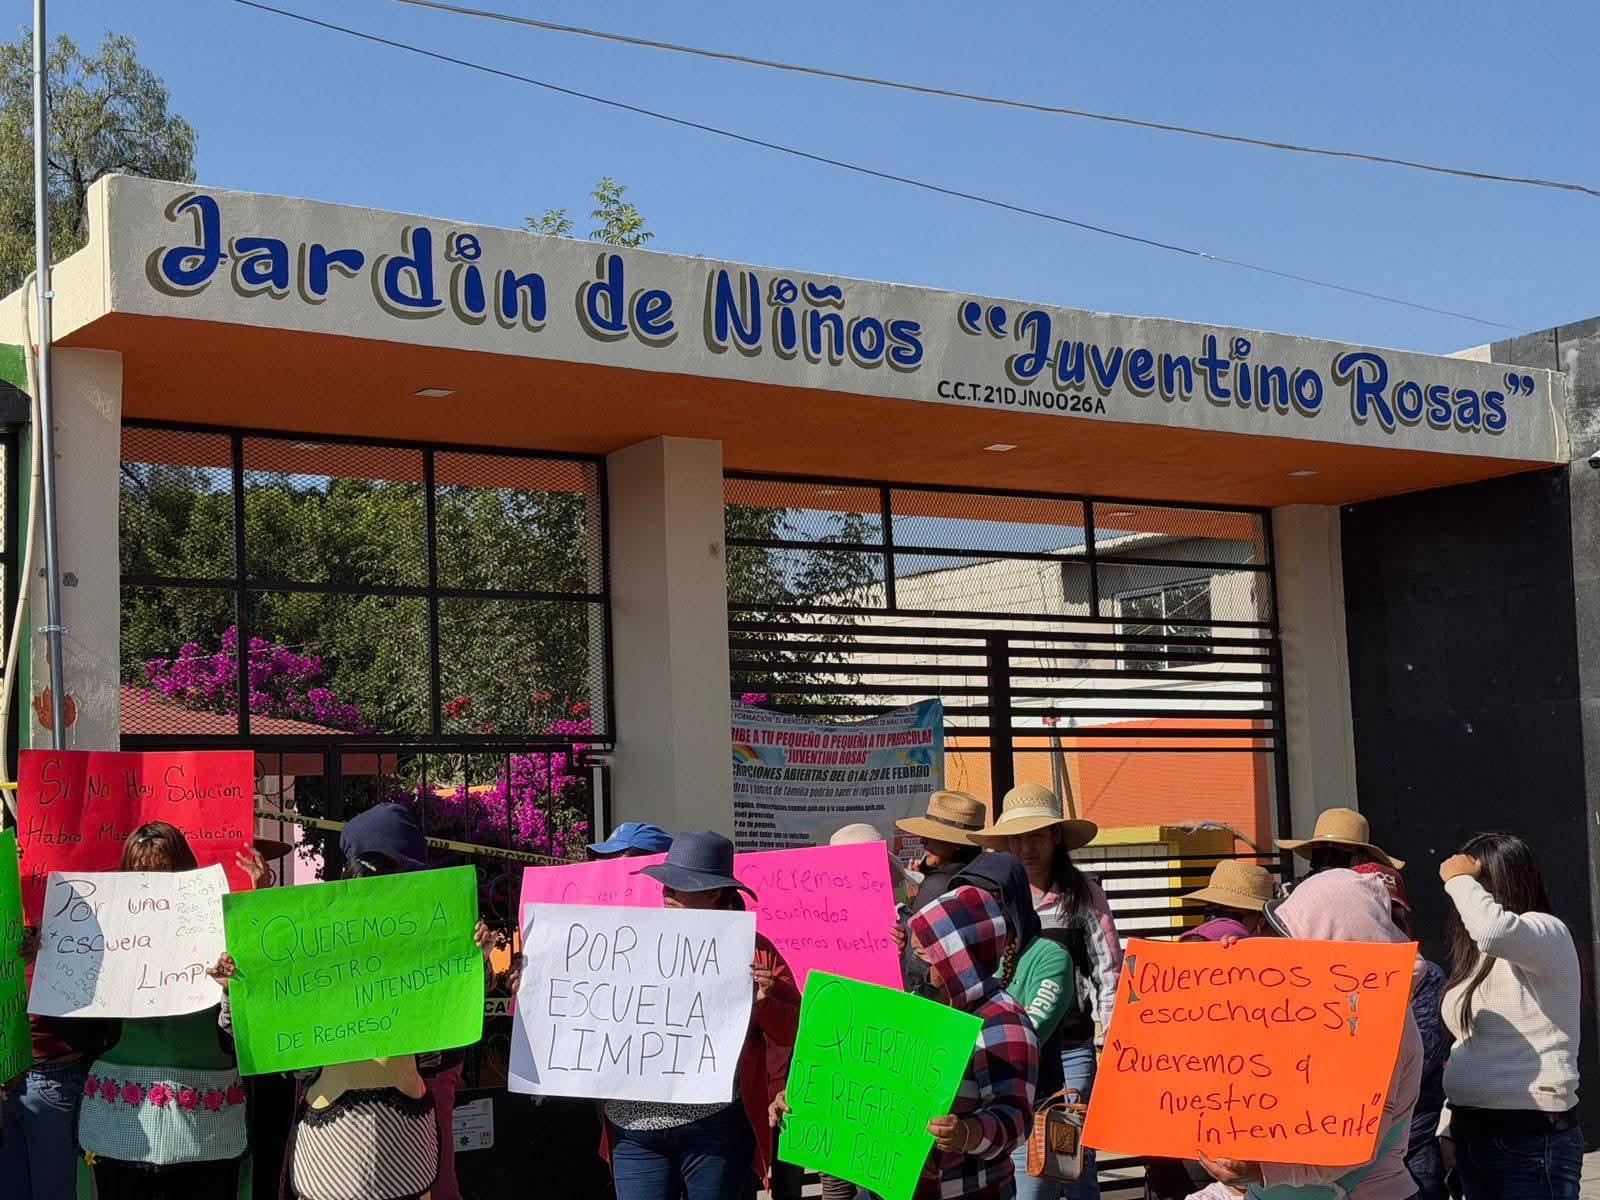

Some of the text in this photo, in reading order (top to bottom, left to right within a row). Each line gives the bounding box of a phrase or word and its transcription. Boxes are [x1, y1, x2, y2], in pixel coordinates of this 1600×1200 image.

[150, 192, 546, 328] Jardin
[580, 252, 677, 342] de
[708, 269, 924, 369] Niños
[753, 729, 759, 744] A
[761, 730, 774, 745] TU
[775, 731, 820, 748] PEQUEÑO
[875, 732, 886, 748] TU
[39, 760, 71, 807] Si
[87, 776, 111, 800] No
[126, 770, 154, 798] Hay
[783, 767, 829, 780] ABIERTAS
[829, 769, 846, 782] DEL
[859, 769, 869, 781] AL
[55, 879, 173, 922] Por una
[428, 900, 447, 935] A
[57, 935, 152, 954] escuela
[565, 922, 720, 979] POR UNA
[273, 955, 382, 1001] NUESTRO
[354, 954, 473, 1008] INTENDENTE
[548, 978, 707, 1031] ESCUELA
[276, 1031, 304, 1053] DE
[547, 1024, 716, 1075] LIMPIA
[791, 1060, 822, 1105] DE
[1160, 1083, 1278, 1114] nuestro
[787, 1116, 835, 1158] DON
